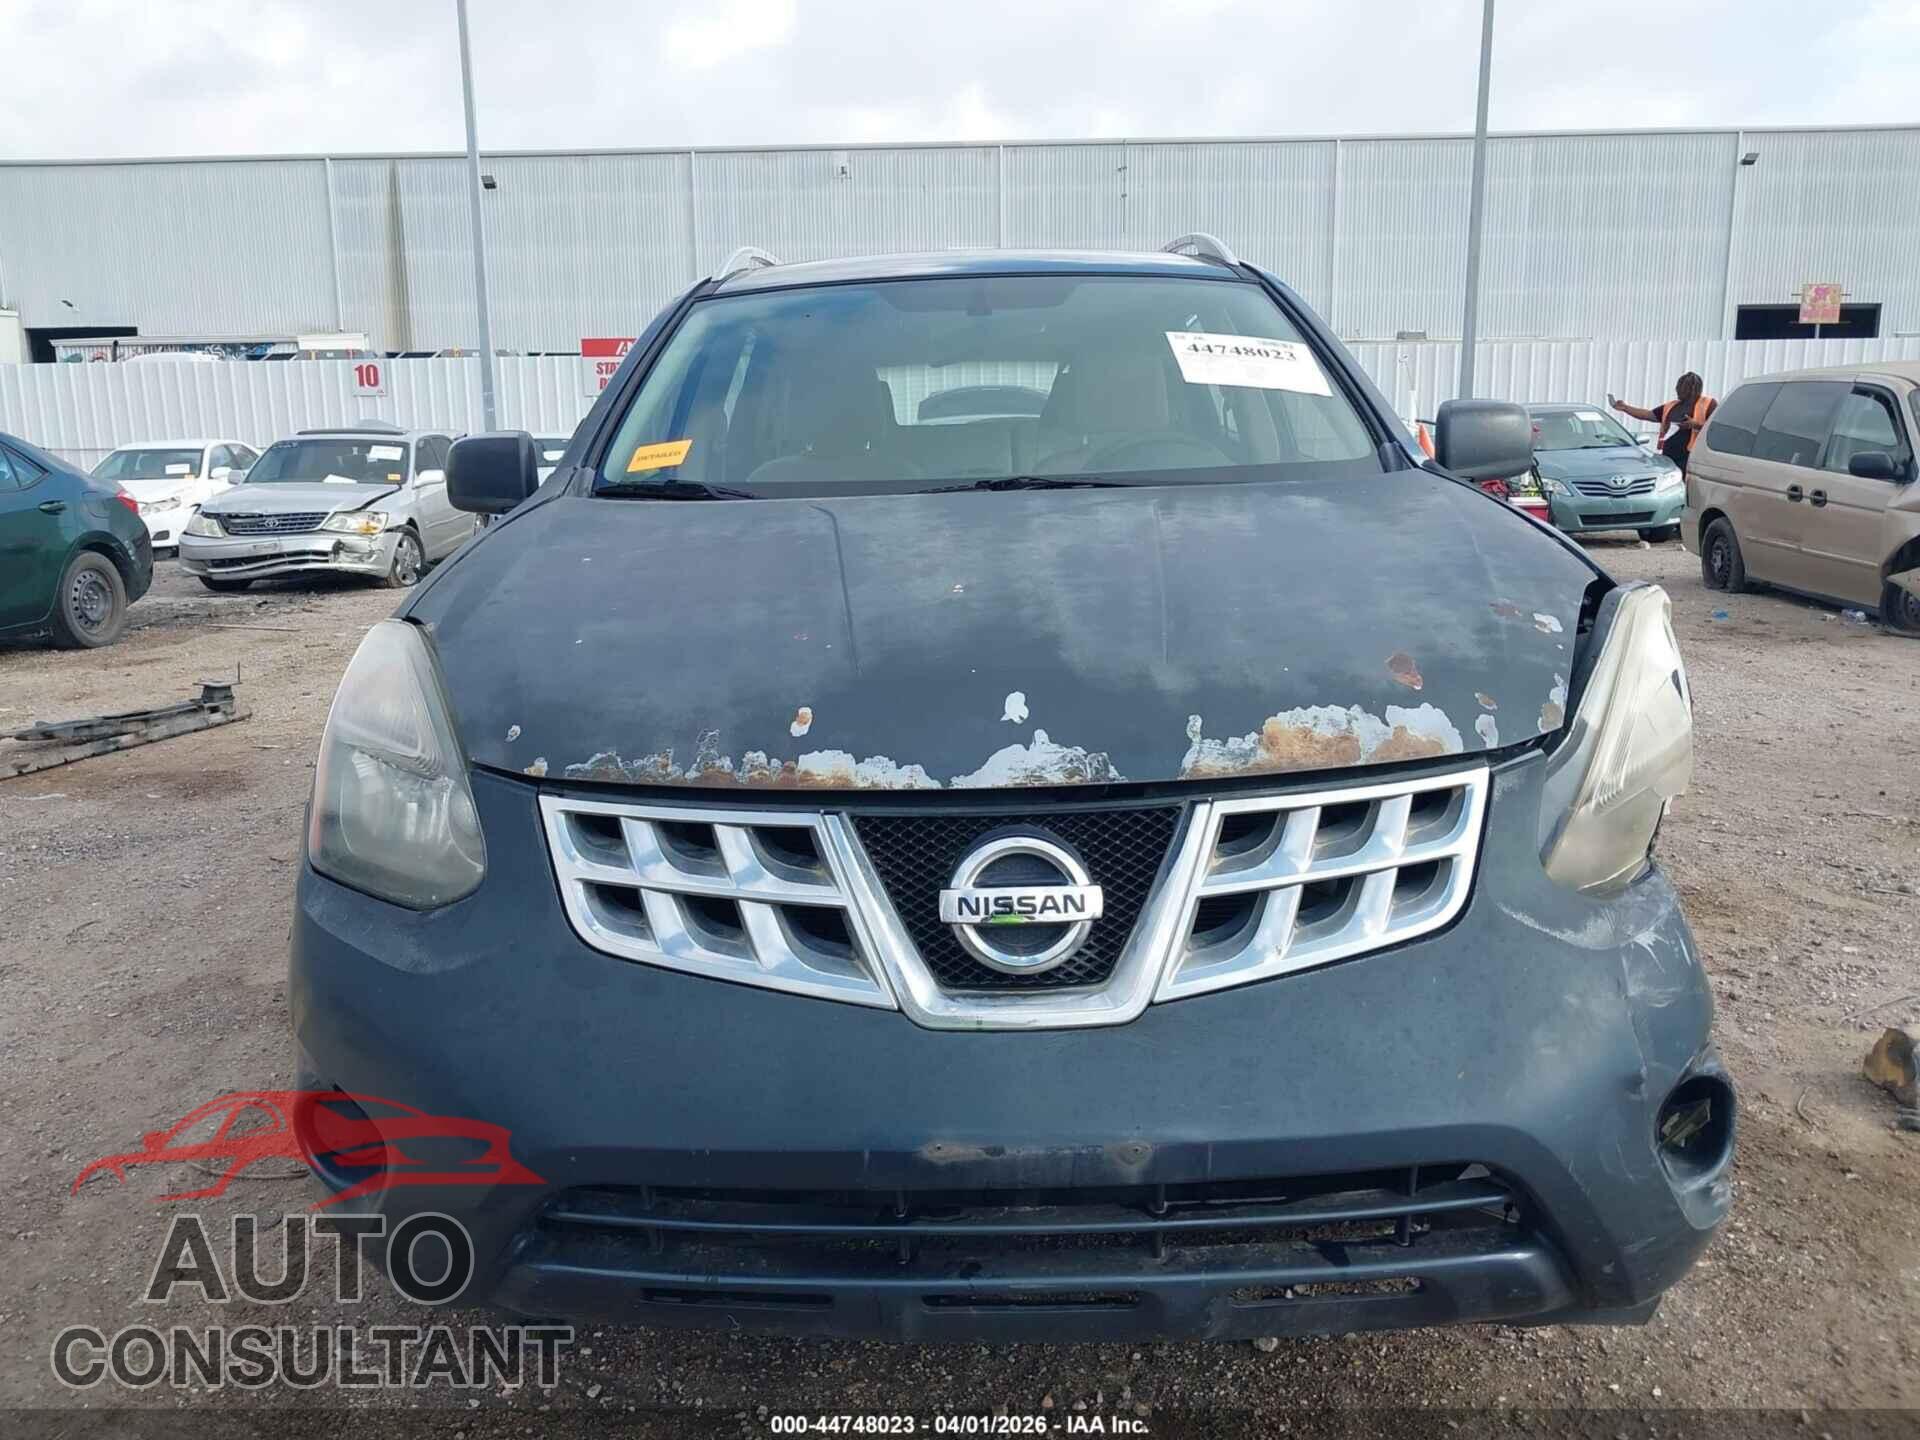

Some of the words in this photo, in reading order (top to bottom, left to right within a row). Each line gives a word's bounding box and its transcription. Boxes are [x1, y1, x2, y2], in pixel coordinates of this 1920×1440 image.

[1187, 343, 1297, 361] 44748023
[354, 364, 379, 387] 10
[957, 894, 1086, 916] NISSAN
